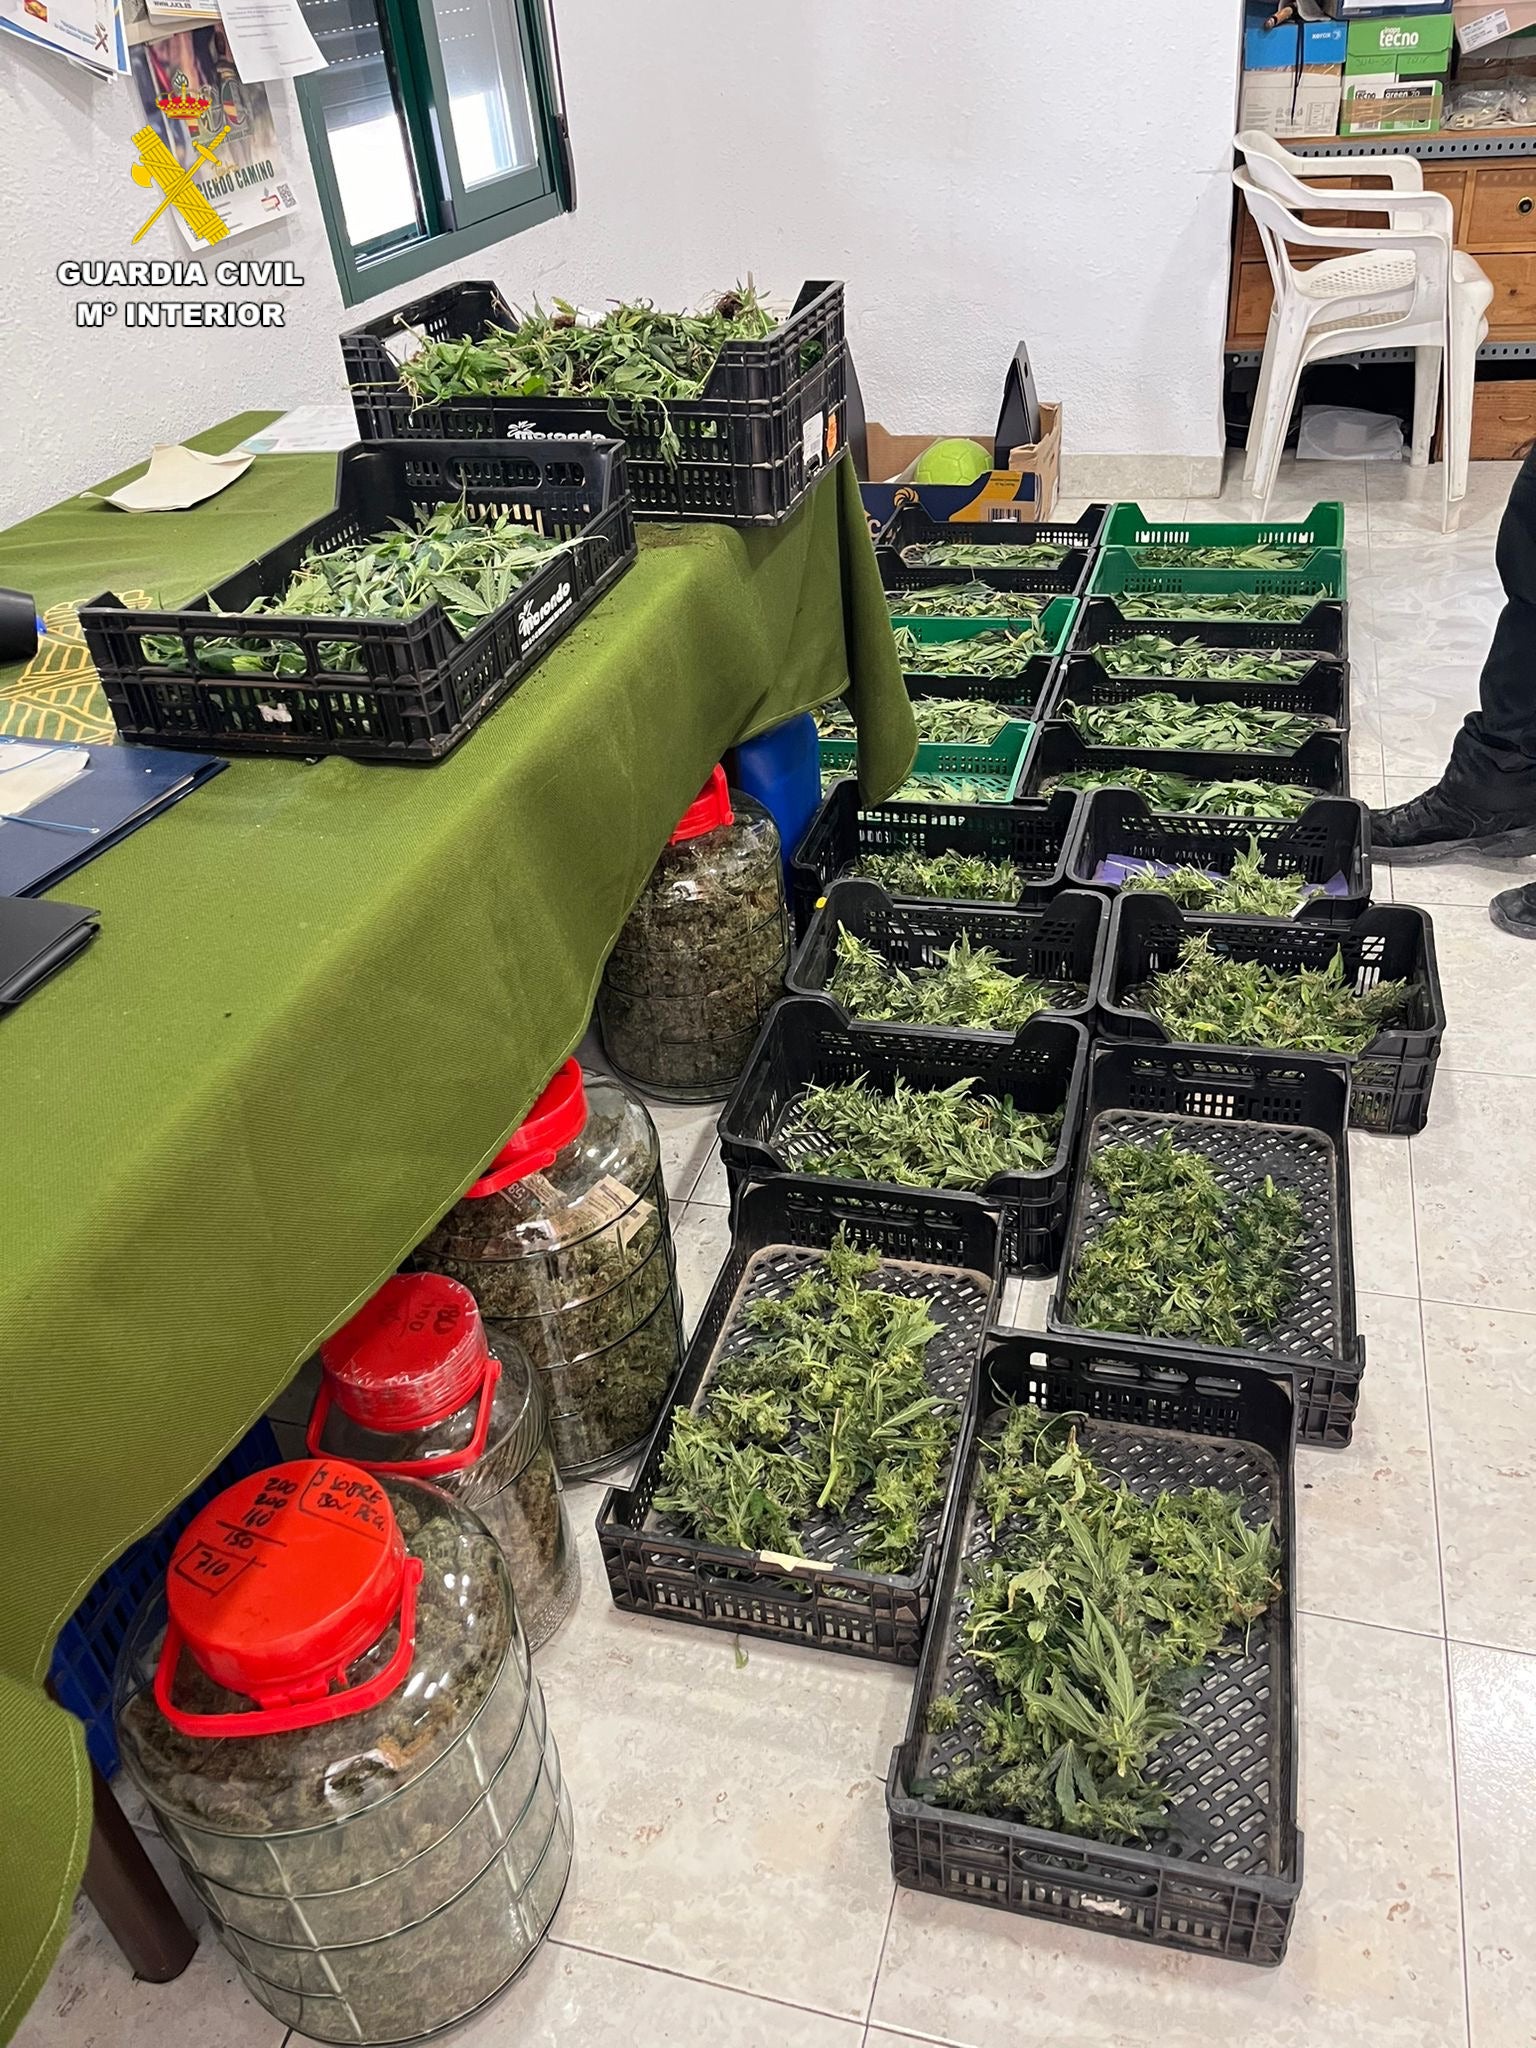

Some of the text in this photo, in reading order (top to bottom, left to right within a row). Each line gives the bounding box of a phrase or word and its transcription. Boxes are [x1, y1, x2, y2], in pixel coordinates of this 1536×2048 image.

[1379, 29, 1419, 47] tecno
[235, 159, 275, 189] CAMINO
[264, 1477, 298, 1495] 200
[254, 1493, 288, 1509] 200
[223, 1529, 254, 1549] 150
[195, 1550, 229, 1575] 710
